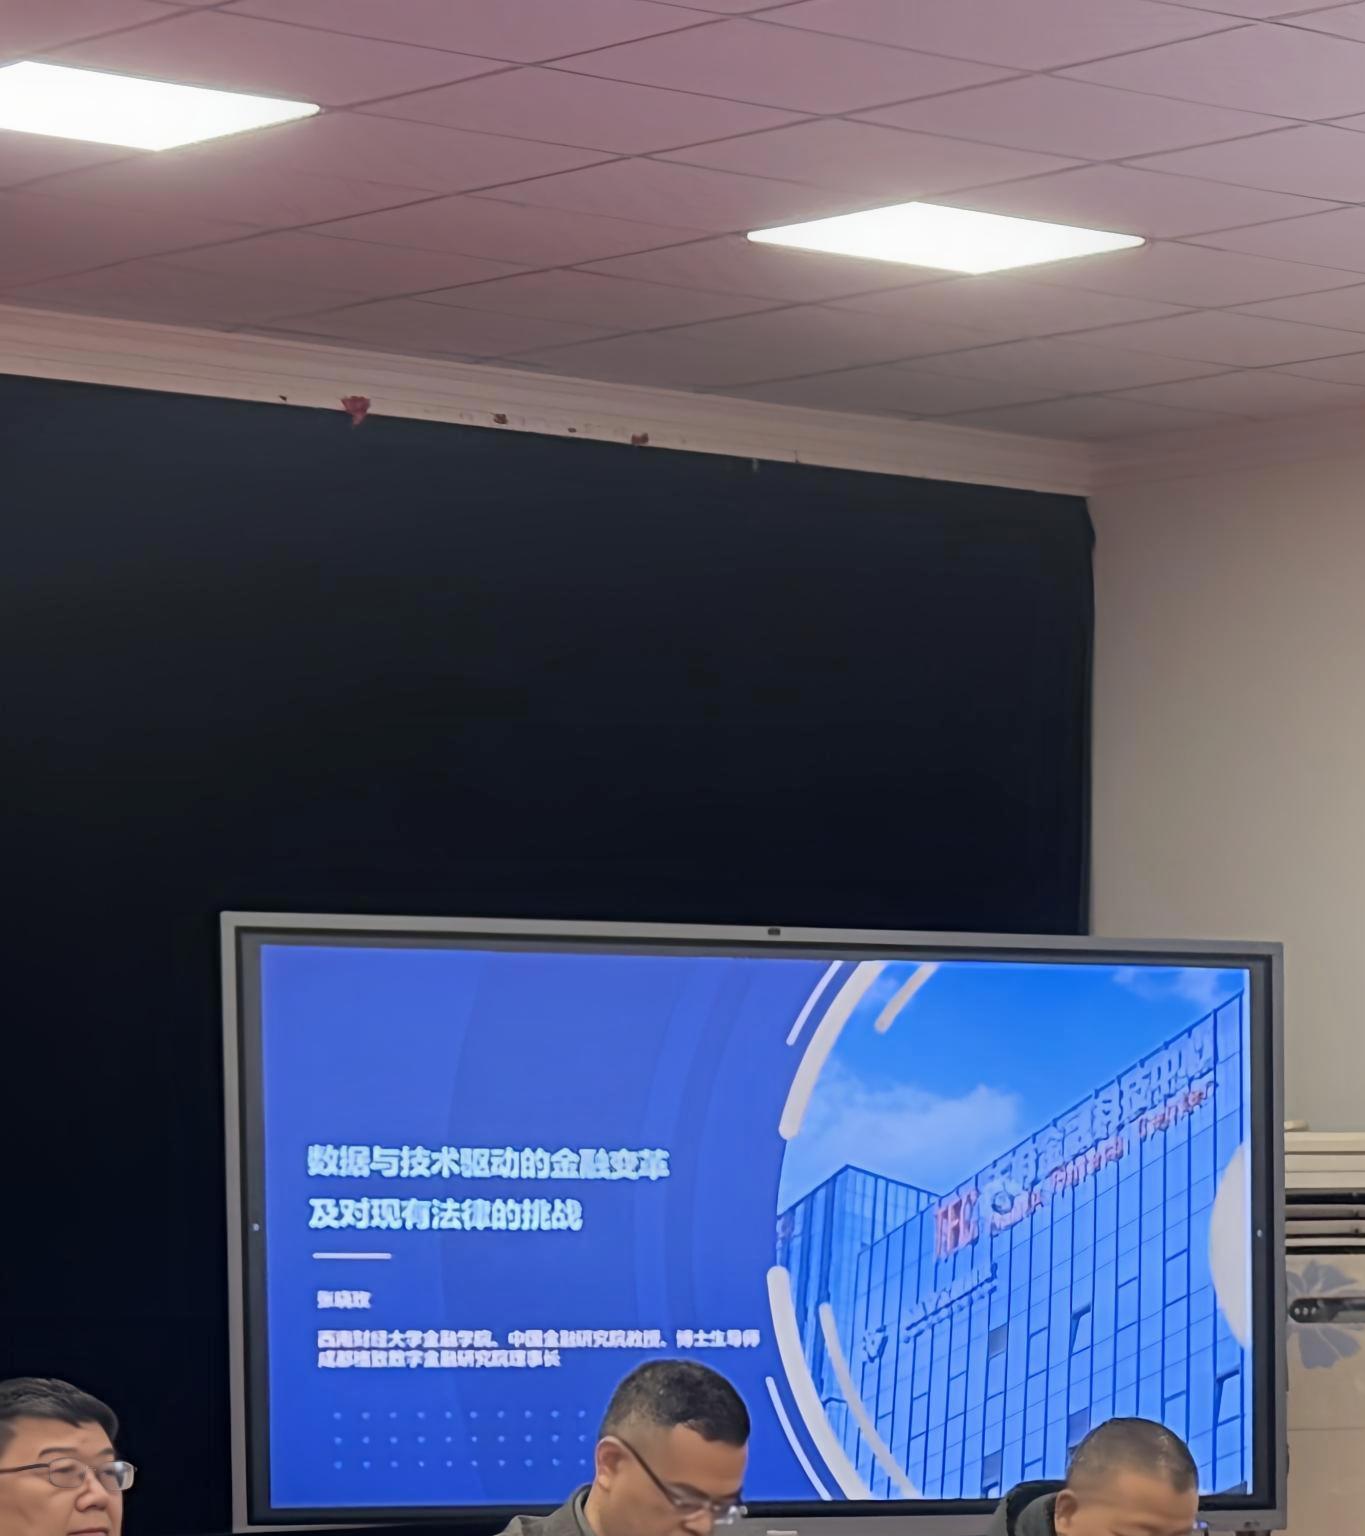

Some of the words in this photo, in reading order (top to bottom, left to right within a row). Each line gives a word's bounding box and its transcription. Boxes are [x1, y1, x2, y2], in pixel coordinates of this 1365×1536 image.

[307, 1145, 670, 1180] 数据与技术驱动的金融变革
[308, 1198, 583, 1231] 及对现有法律的挑战
